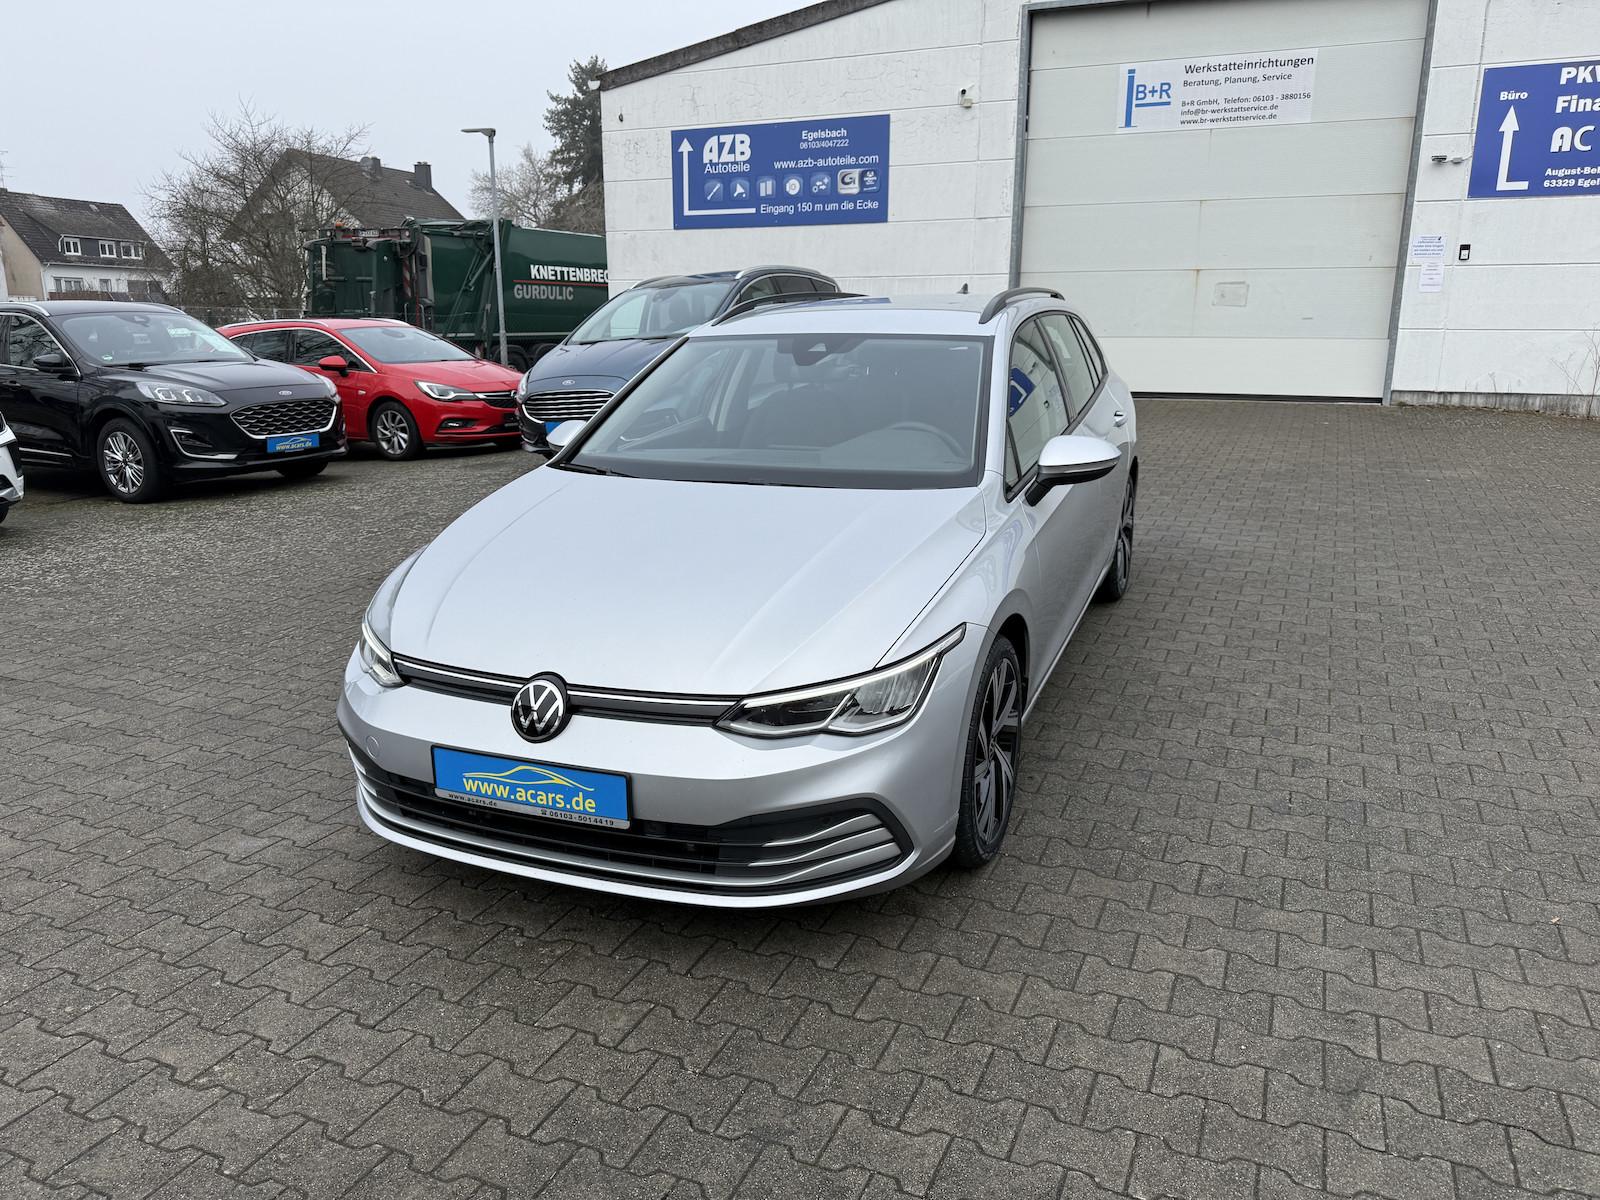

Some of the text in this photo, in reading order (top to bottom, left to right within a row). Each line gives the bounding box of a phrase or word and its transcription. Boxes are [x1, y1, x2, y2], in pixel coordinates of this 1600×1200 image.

[1184, 57, 1314, 74] Werkstatteinrichtungen
[1183, 72, 1292, 87] Beratung, Planung, Service
[1560, 64, 1600, 85] PK
[1196, 99, 1220, 107] GmbH,
[1224, 96, 1252, 104] Telefon:
[1252, 94, 1274, 102] 06103
[1280, 92, 1312, 101] 3880156
[1499, 90, 1529, 101] Büro
[1180, 103, 1279, 116] info@br-werkstattservice.de
[1180, 112, 1278, 125] www.br-werkstattservice.de
[801, 127, 848, 141] Egelsbach
[1550, 125, 1596, 153] AC
[703, 133, 752, 164] AZB
[799, 138, 850, 149] 06103/4047222
[704, 162, 751, 174] Autoteile
[773, 154, 880, 169] www.azb-autoteile.com
[1543, 178, 1576, 188] 63329
[760, 199, 880, 215] Eingang 150 m um die Ecke
[513, 284, 574, 301] GURDULIC
[462, 777, 597, 813] www.acars.de
